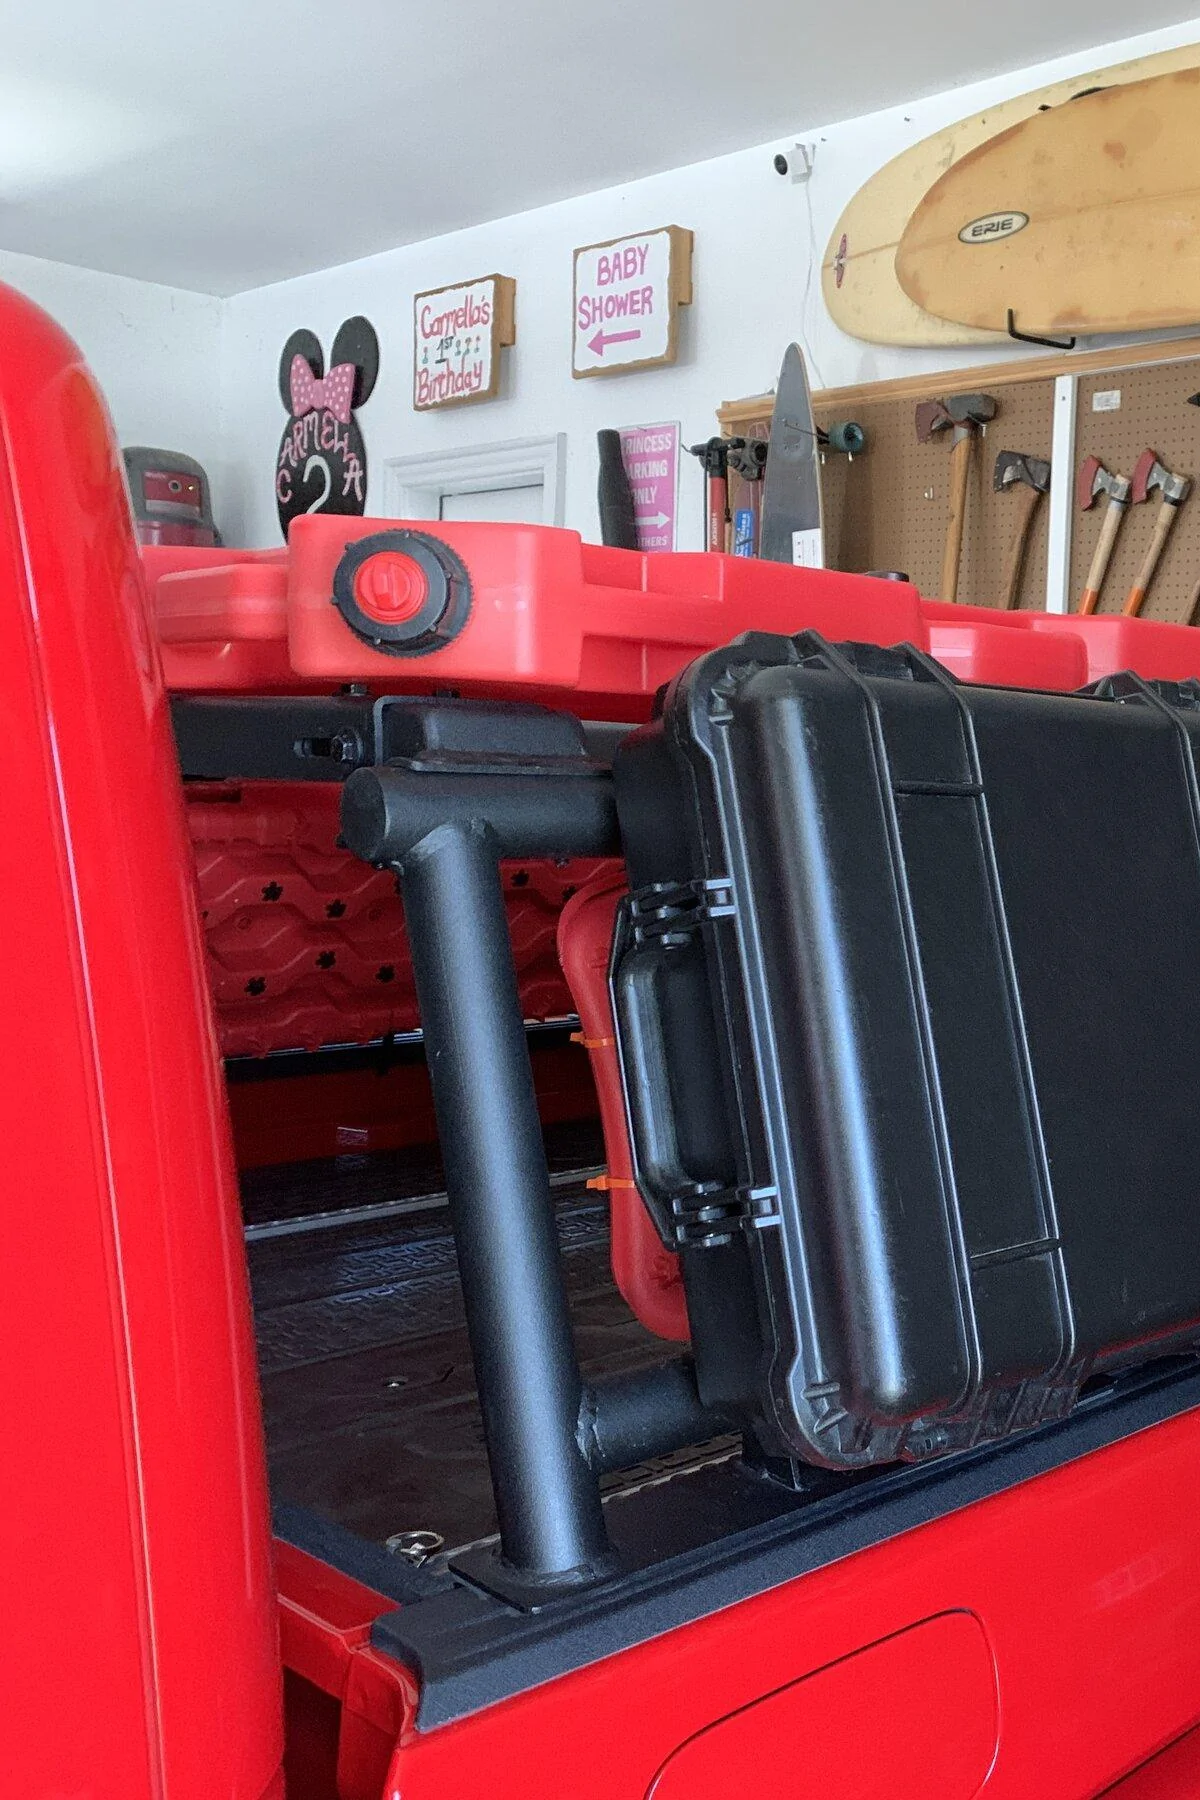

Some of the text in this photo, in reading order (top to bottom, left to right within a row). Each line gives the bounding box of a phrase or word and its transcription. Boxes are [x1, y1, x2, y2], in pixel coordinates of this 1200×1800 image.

[971, 218, 1013, 236] ERIE
[596, 243, 650, 286] BABY
[420, 294, 491, 339] Carmella's
[577, 285, 654, 331] SHOWER
[416, 356, 484, 404] Birthday
[626, 459, 668, 480] ARKING
[639, 536, 668, 547] THERS
